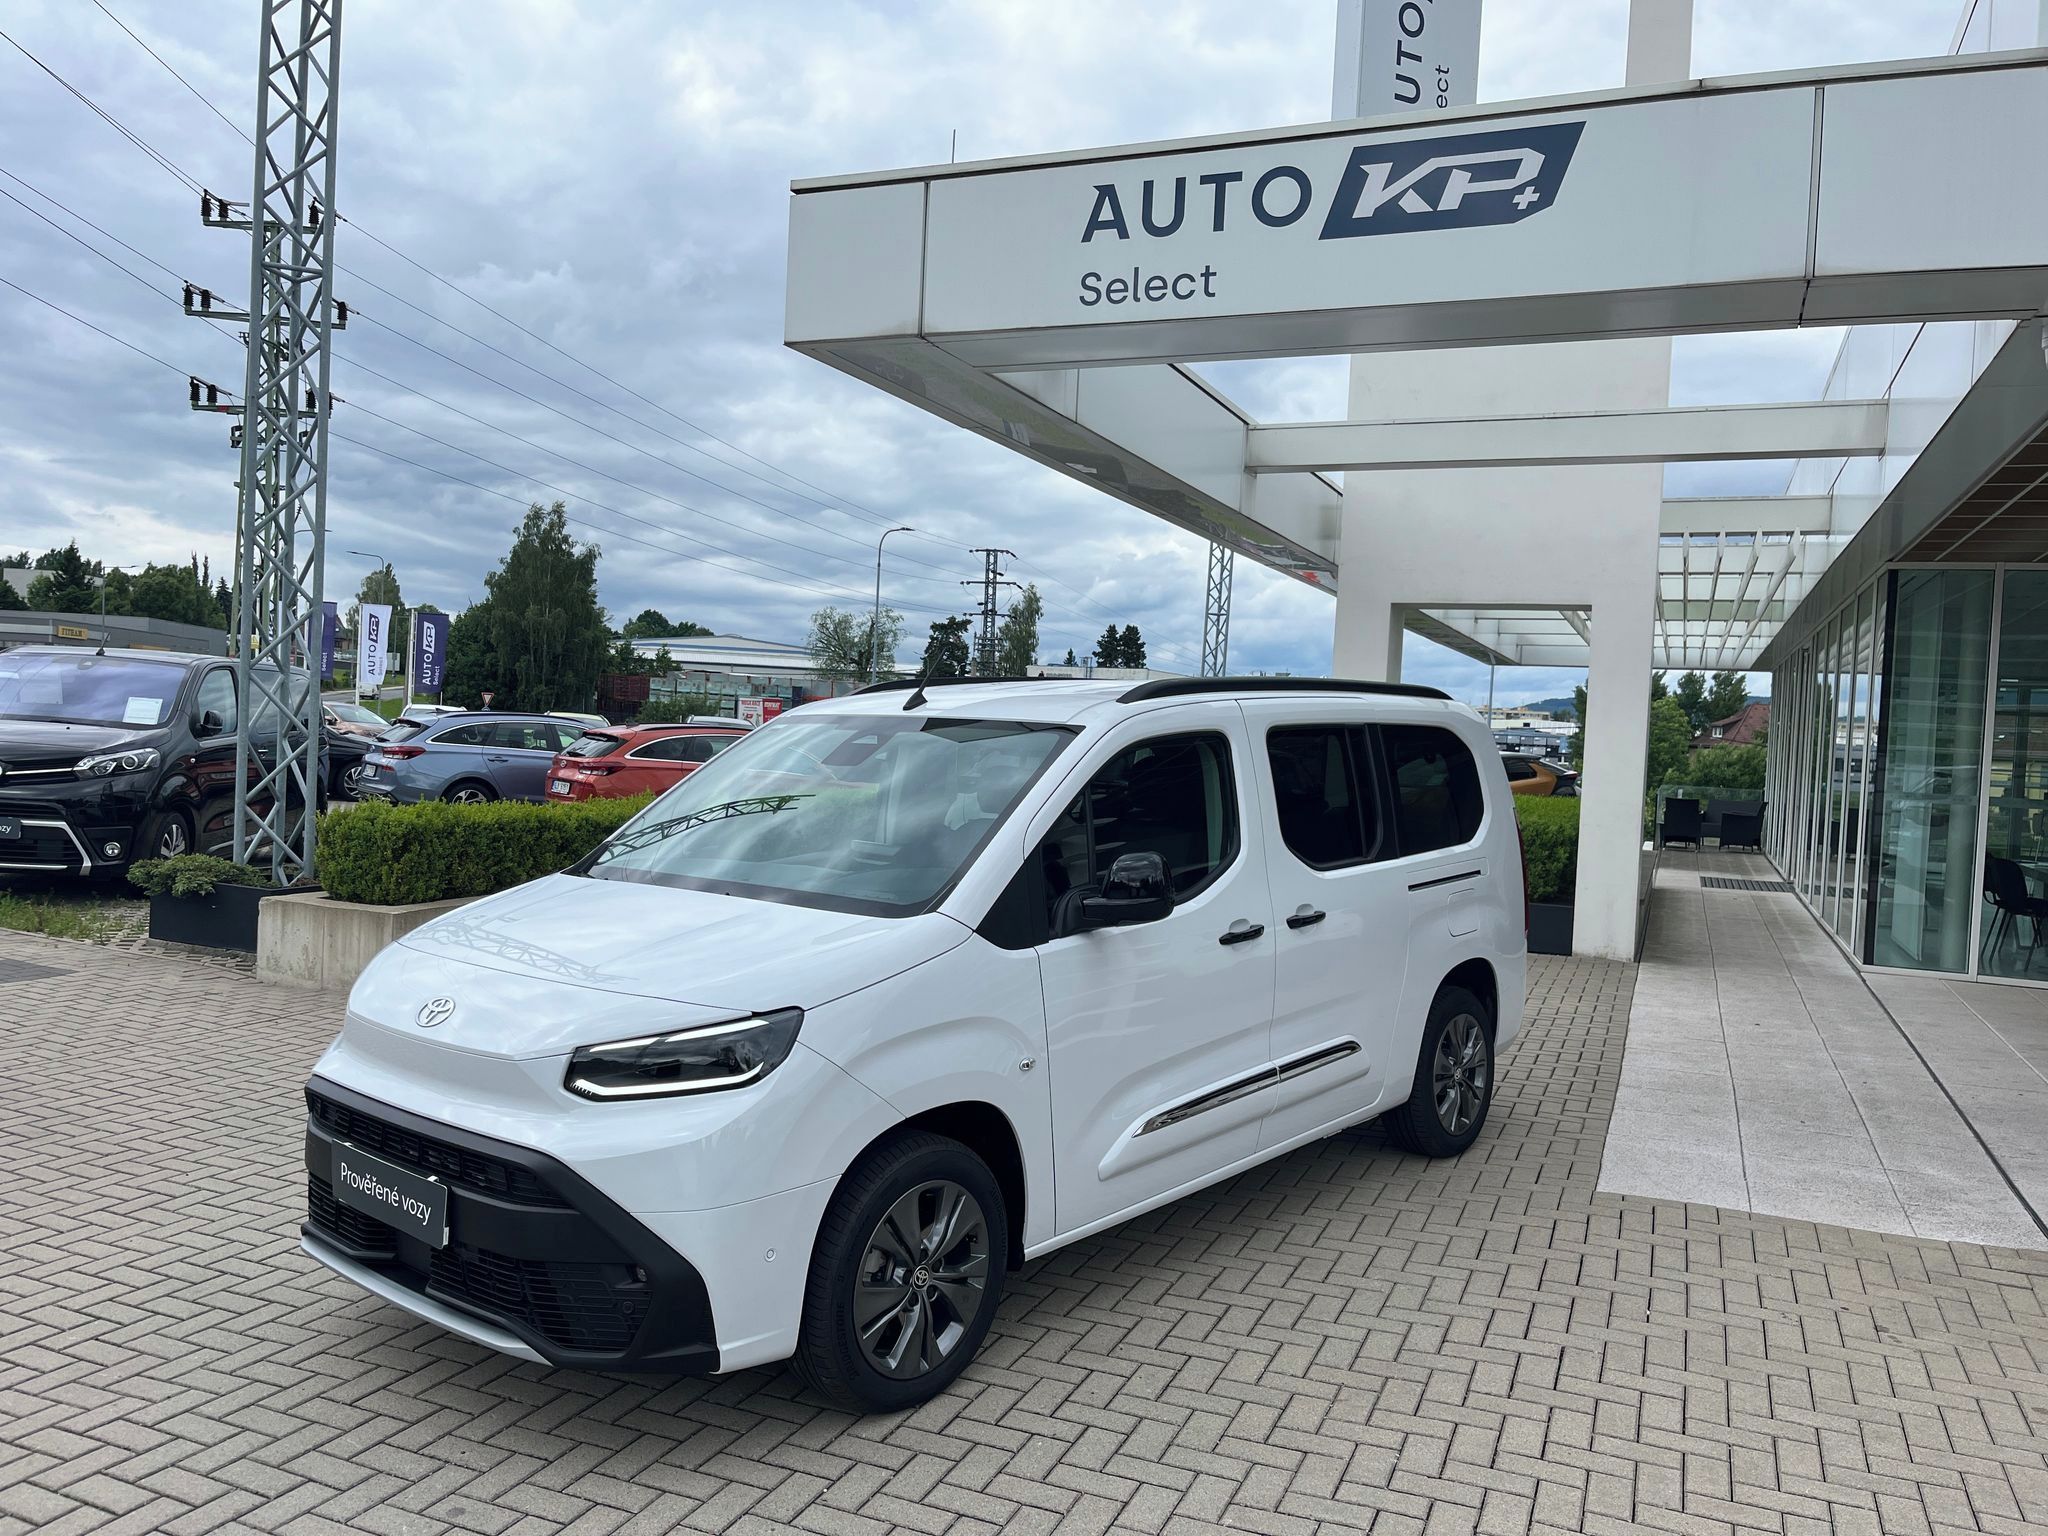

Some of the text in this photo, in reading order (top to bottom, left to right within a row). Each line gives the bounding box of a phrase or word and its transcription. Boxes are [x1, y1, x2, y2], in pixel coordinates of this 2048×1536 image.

[1394, 1, 1425, 105] UTO
[1435, 64, 1450, 109] ect
[1080, 165, 1313, 243] AUTO
[1078, 264, 1218, 307] Select
[367, 644, 377, 676] AUTO
[422, 653, 433, 686] AUTO
[432, 665, 441, 686] Select
[340, 1162, 432, 1226] Prověřené vozy
